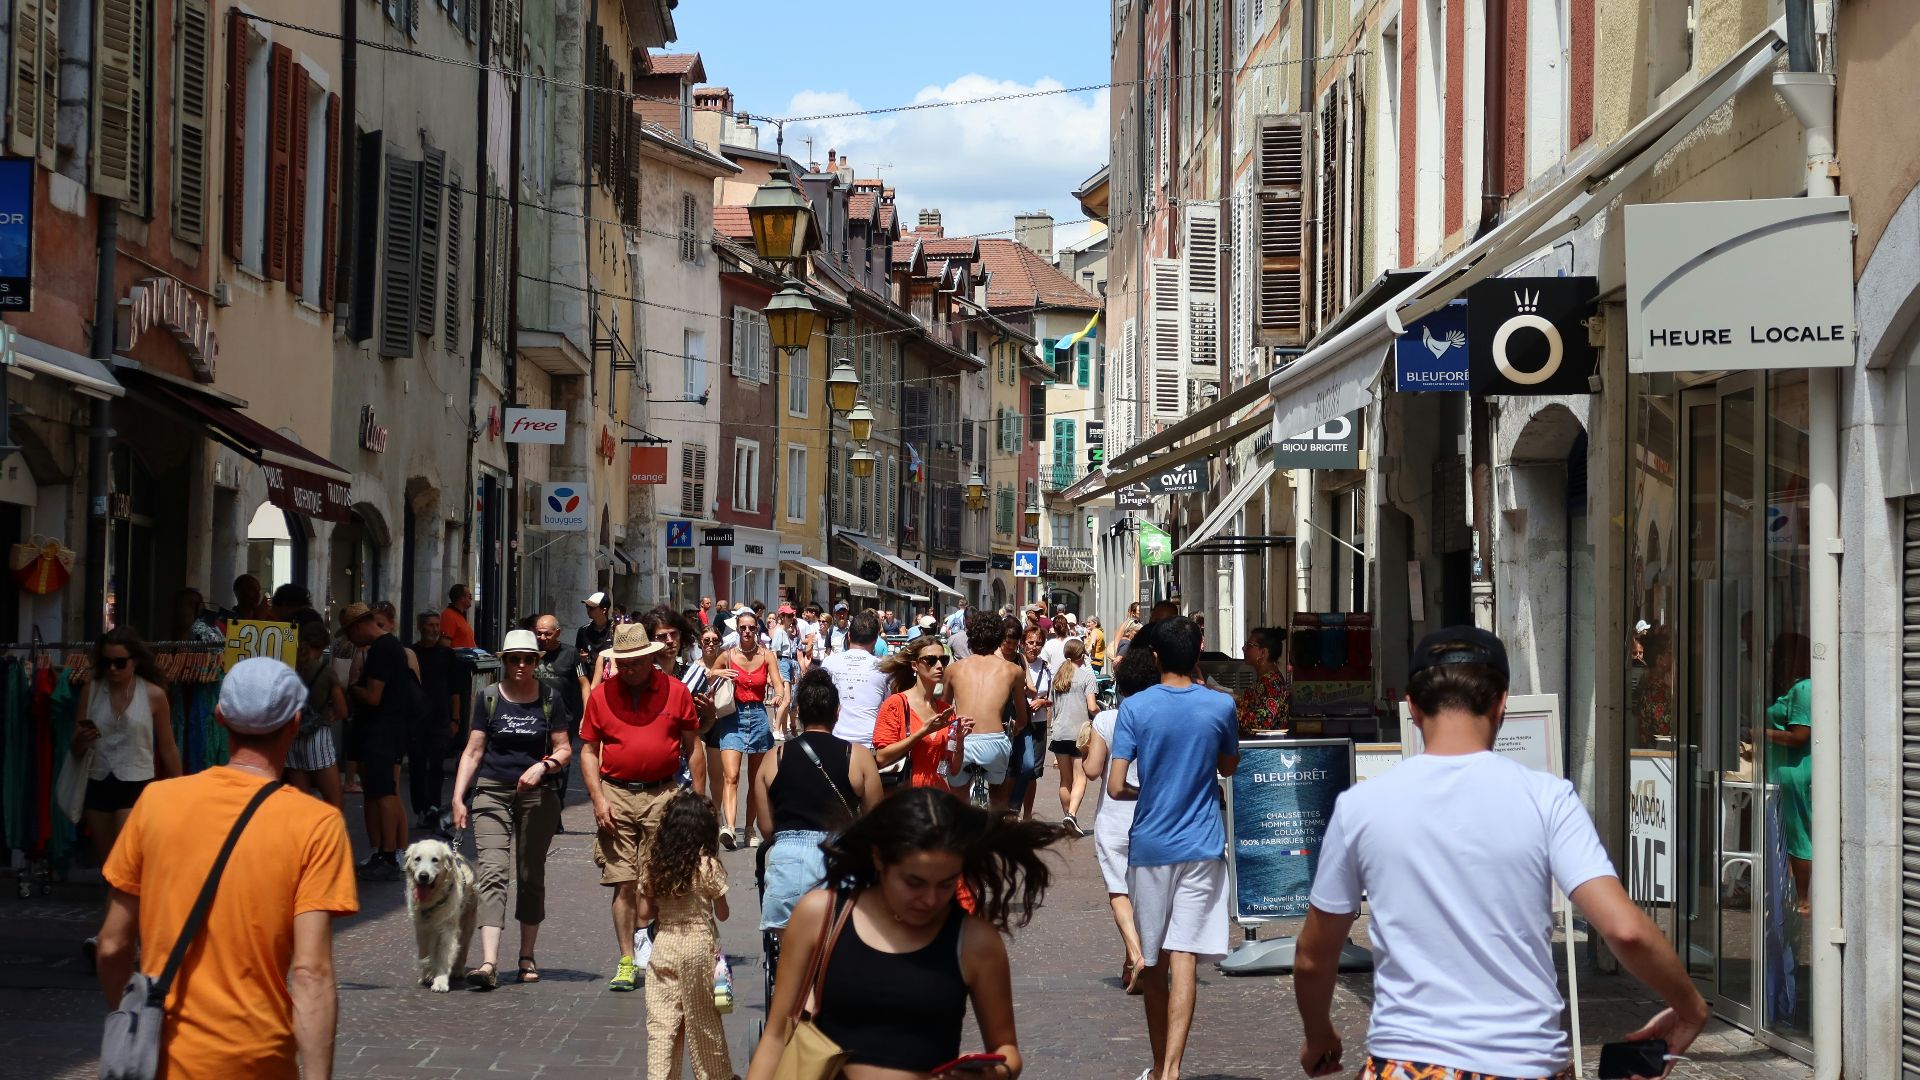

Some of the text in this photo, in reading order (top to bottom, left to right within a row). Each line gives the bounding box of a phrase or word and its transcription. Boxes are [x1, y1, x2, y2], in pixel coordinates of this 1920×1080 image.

[1650, 325, 1845, 347] HEURE LOCALE
[511, 416, 558, 434] free
[1282, 443, 1349, 453] BIJOU BRIGITTE
[632, 474, 663, 483] orange
[1161, 469, 1198, 486] avril
[544, 514, 584, 526] bouygues
[706, 533, 732, 541] minelli
[1254, 768, 1328, 782] BLEUFORÊT
[1266, 811, 1321, 820] CHAUSSETTES
[1631, 794, 1666, 830] PANDORA
[1263, 895, 1294, 903] Nouvelle
